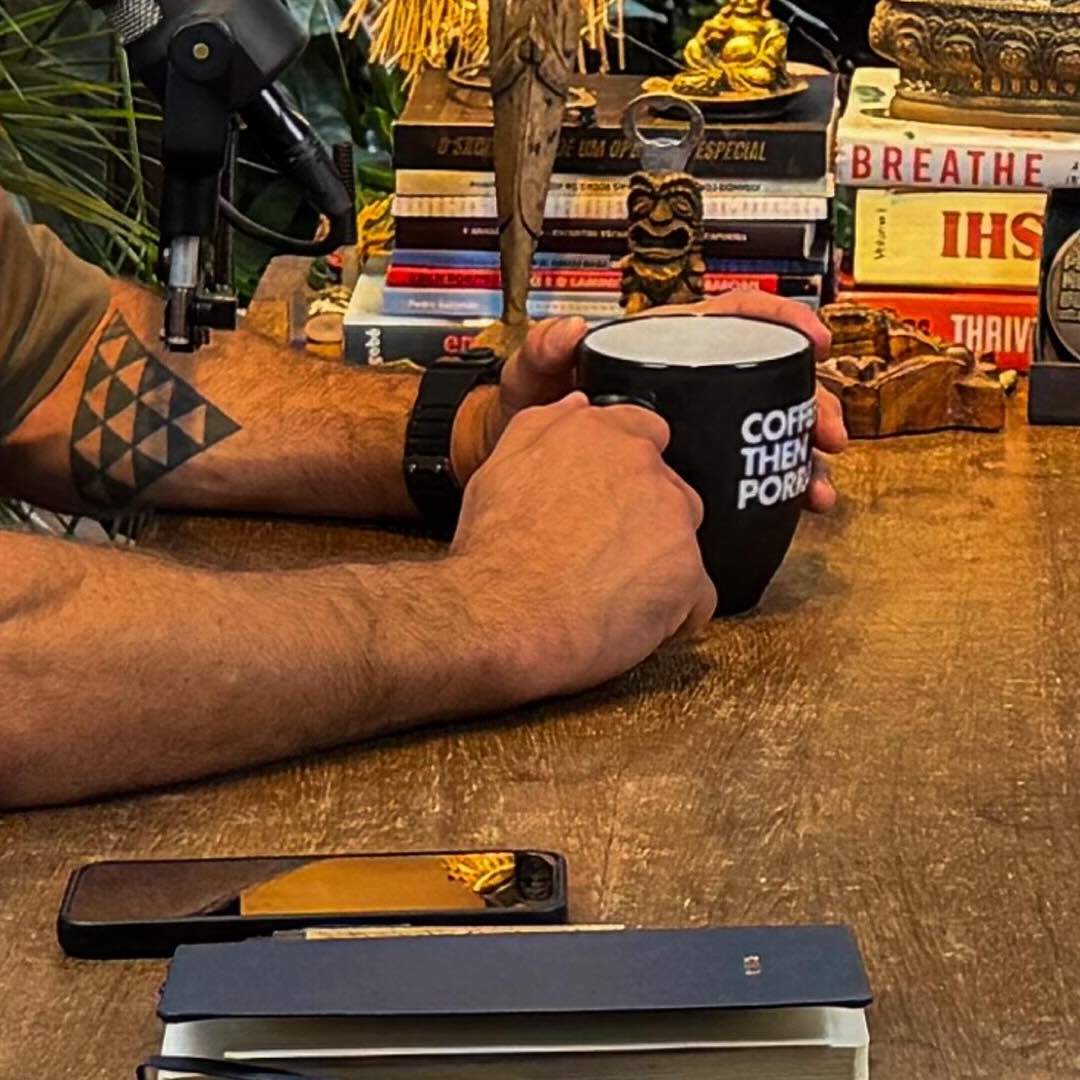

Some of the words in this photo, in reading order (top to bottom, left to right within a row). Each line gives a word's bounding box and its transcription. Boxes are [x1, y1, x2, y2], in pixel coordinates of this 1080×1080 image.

[696, 141, 768, 161] ESPECIAL
[851, 144, 1044, 188] BREATHE
[950, 314, 1037, 353] THRIV
[740, 433, 809, 476] THEN
